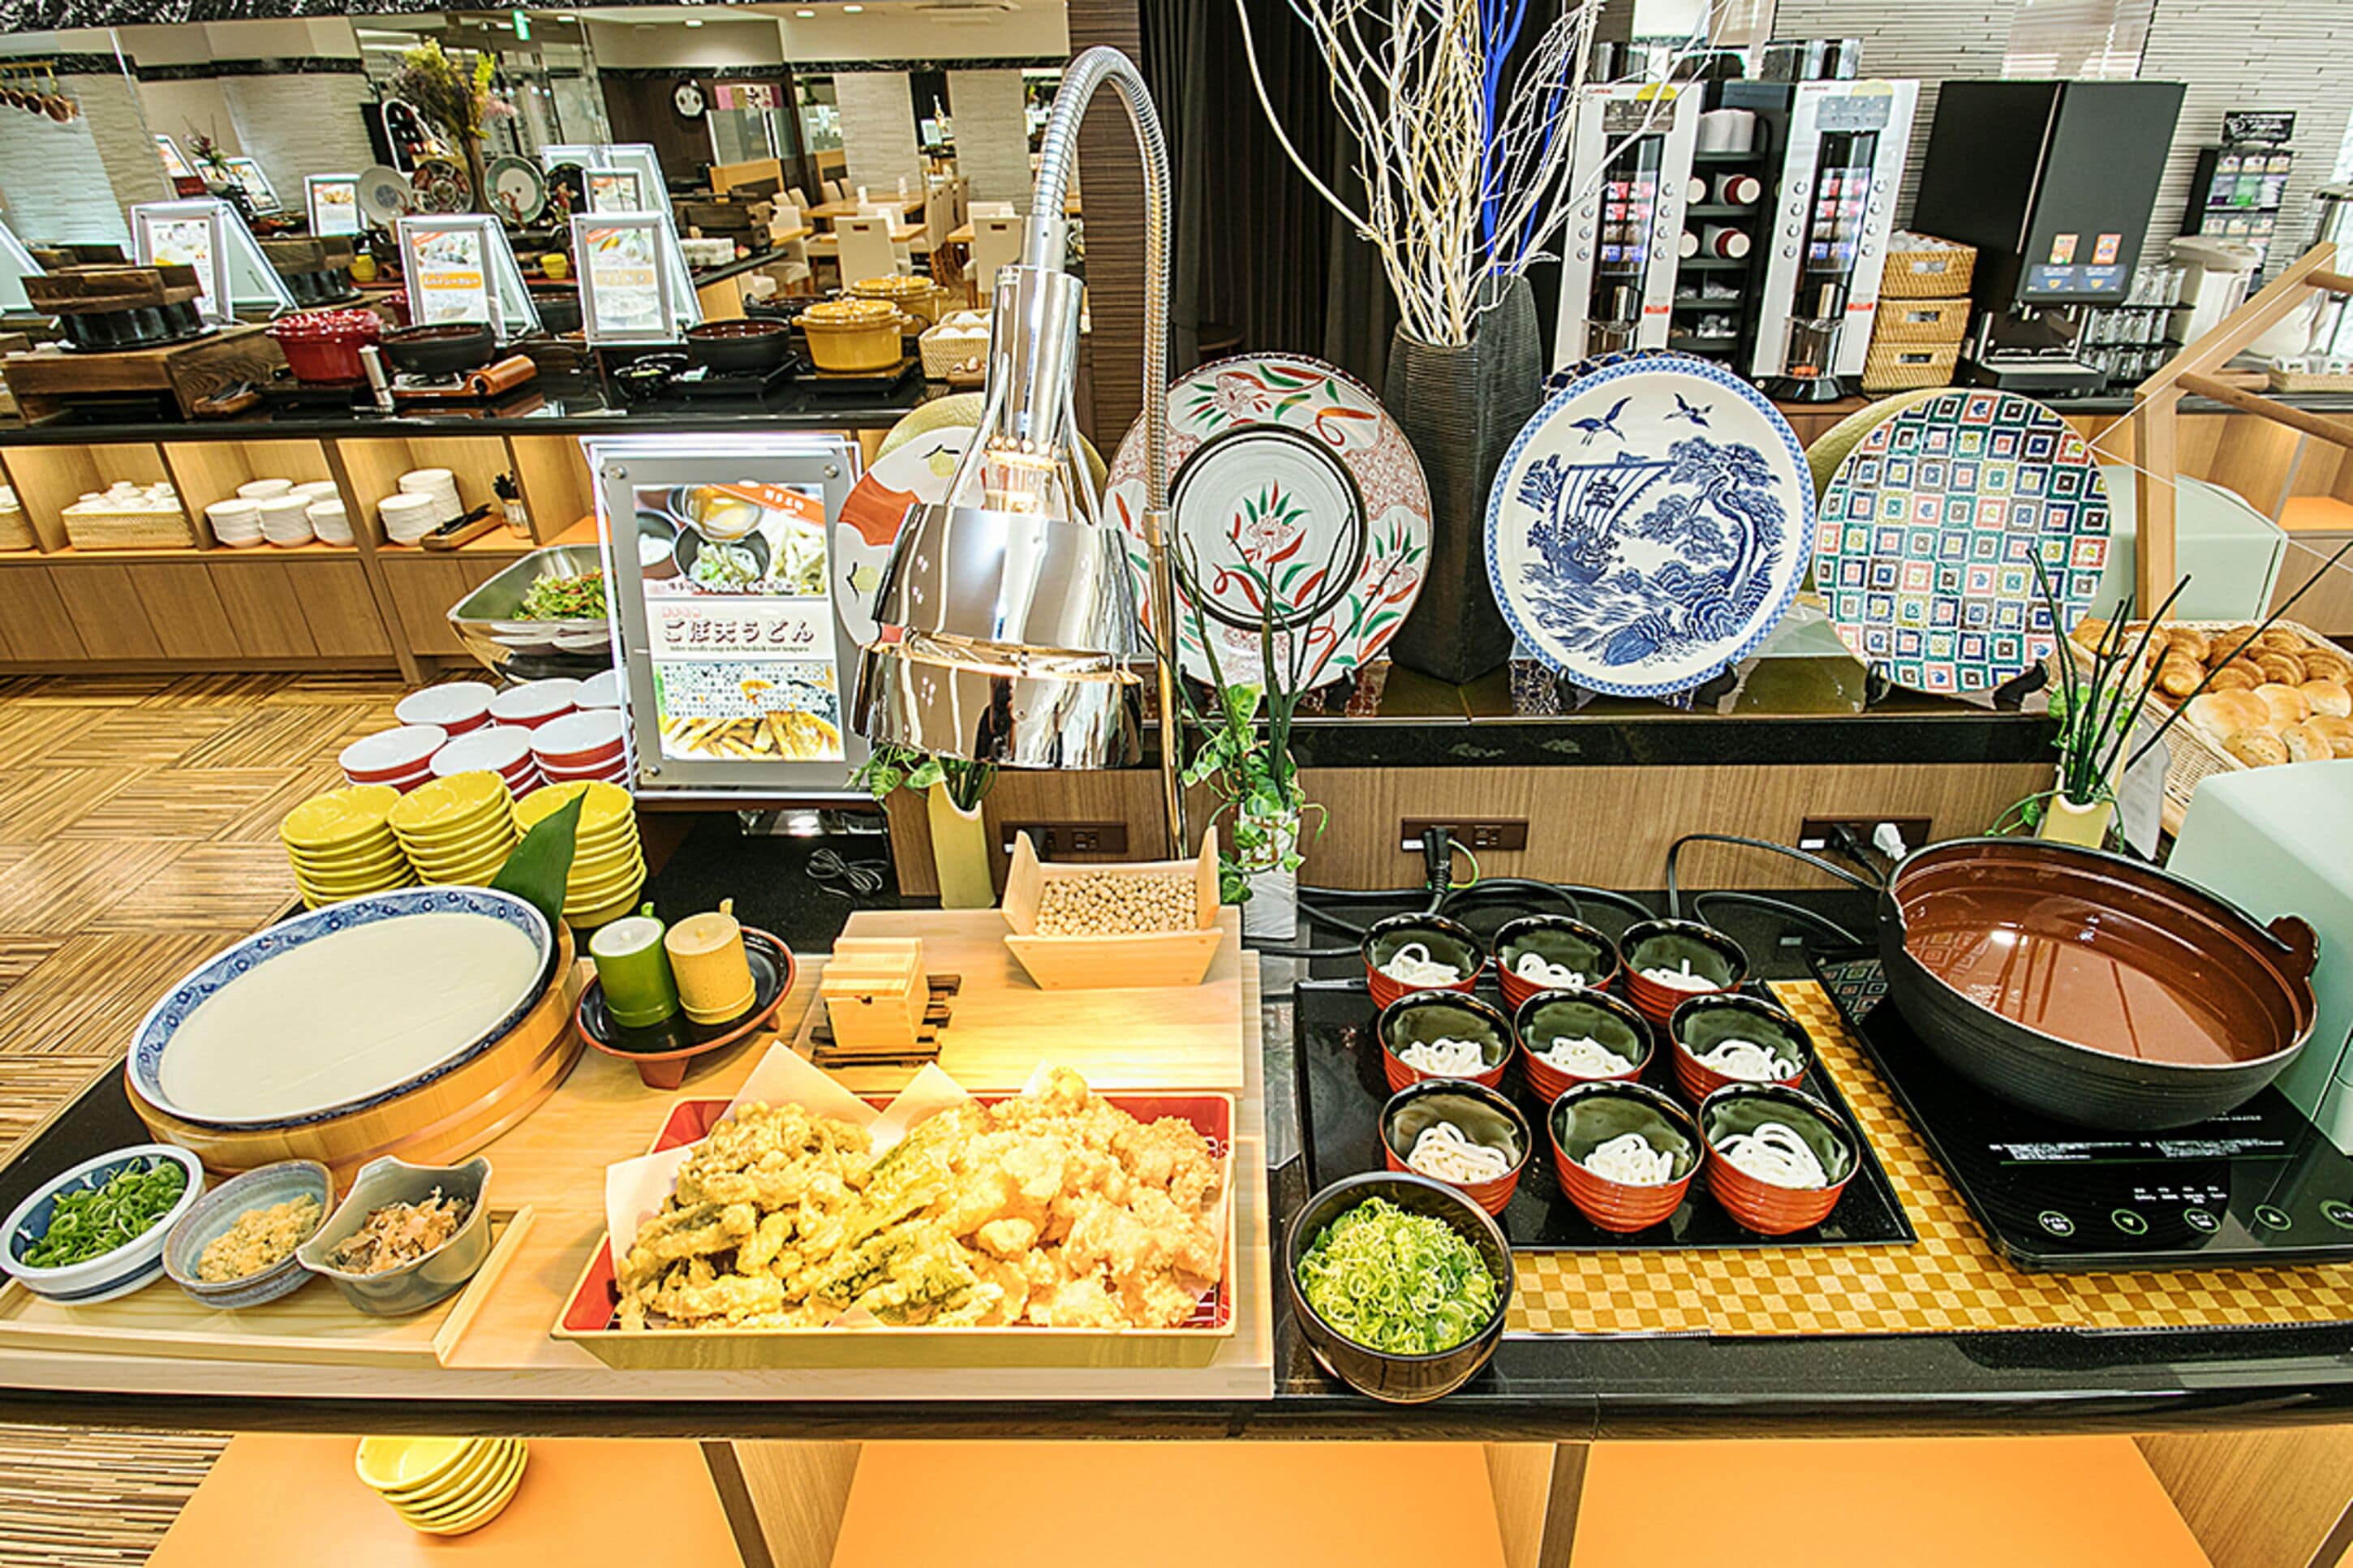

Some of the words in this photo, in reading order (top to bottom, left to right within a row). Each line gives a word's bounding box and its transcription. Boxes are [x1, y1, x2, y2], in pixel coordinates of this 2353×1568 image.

[664, 619, 815, 644] ごぼ天うどん
